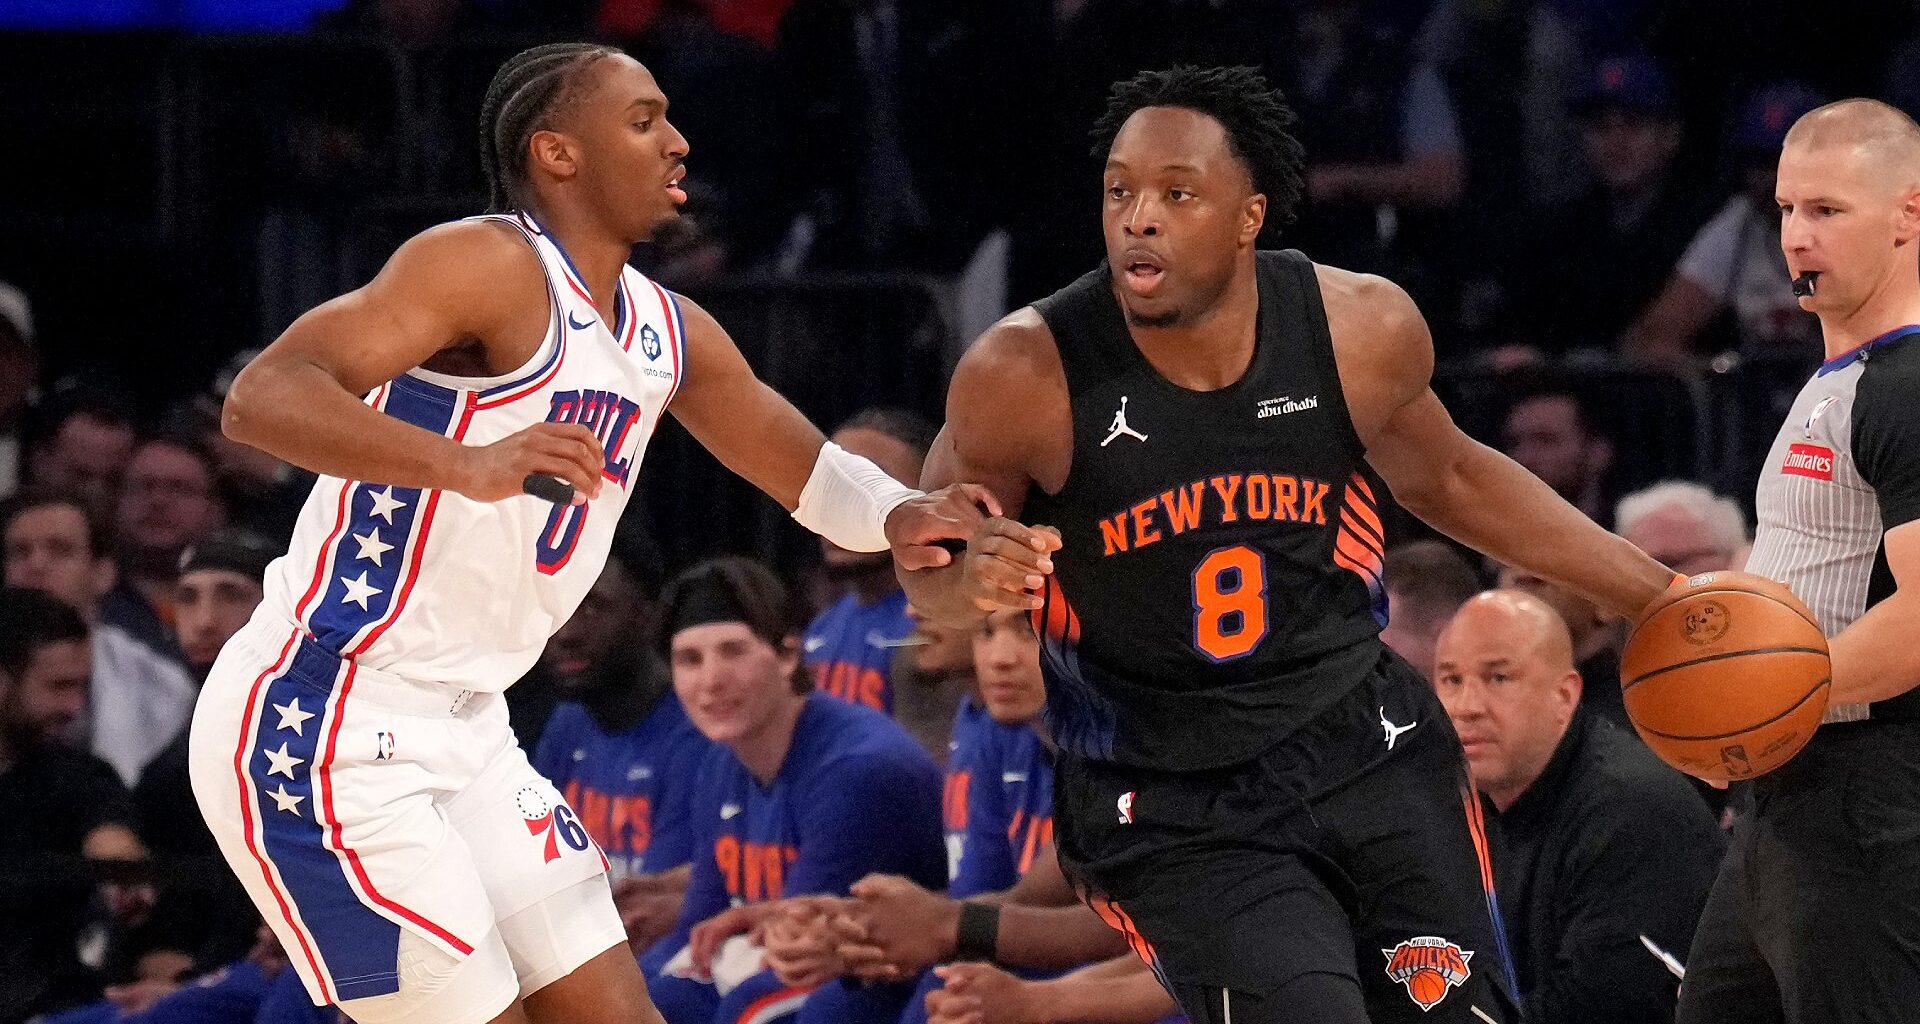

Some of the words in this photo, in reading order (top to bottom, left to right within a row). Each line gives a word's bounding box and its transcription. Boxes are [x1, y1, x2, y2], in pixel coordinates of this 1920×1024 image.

[1257, 405, 1282, 419] abu
[1282, 395, 1318, 414] dhabi
[1784, 450, 1831, 473] Emirates
[1098, 479, 1205, 558] NEW
[1210, 471, 1331, 527] YORK
[1190, 544, 1270, 665] 8
[522, 803, 589, 865] 76
[1411, 938, 1427, 947] NEW
[1427, 938, 1445, 948] YORK
[1388, 944, 1468, 976] KNICKS
